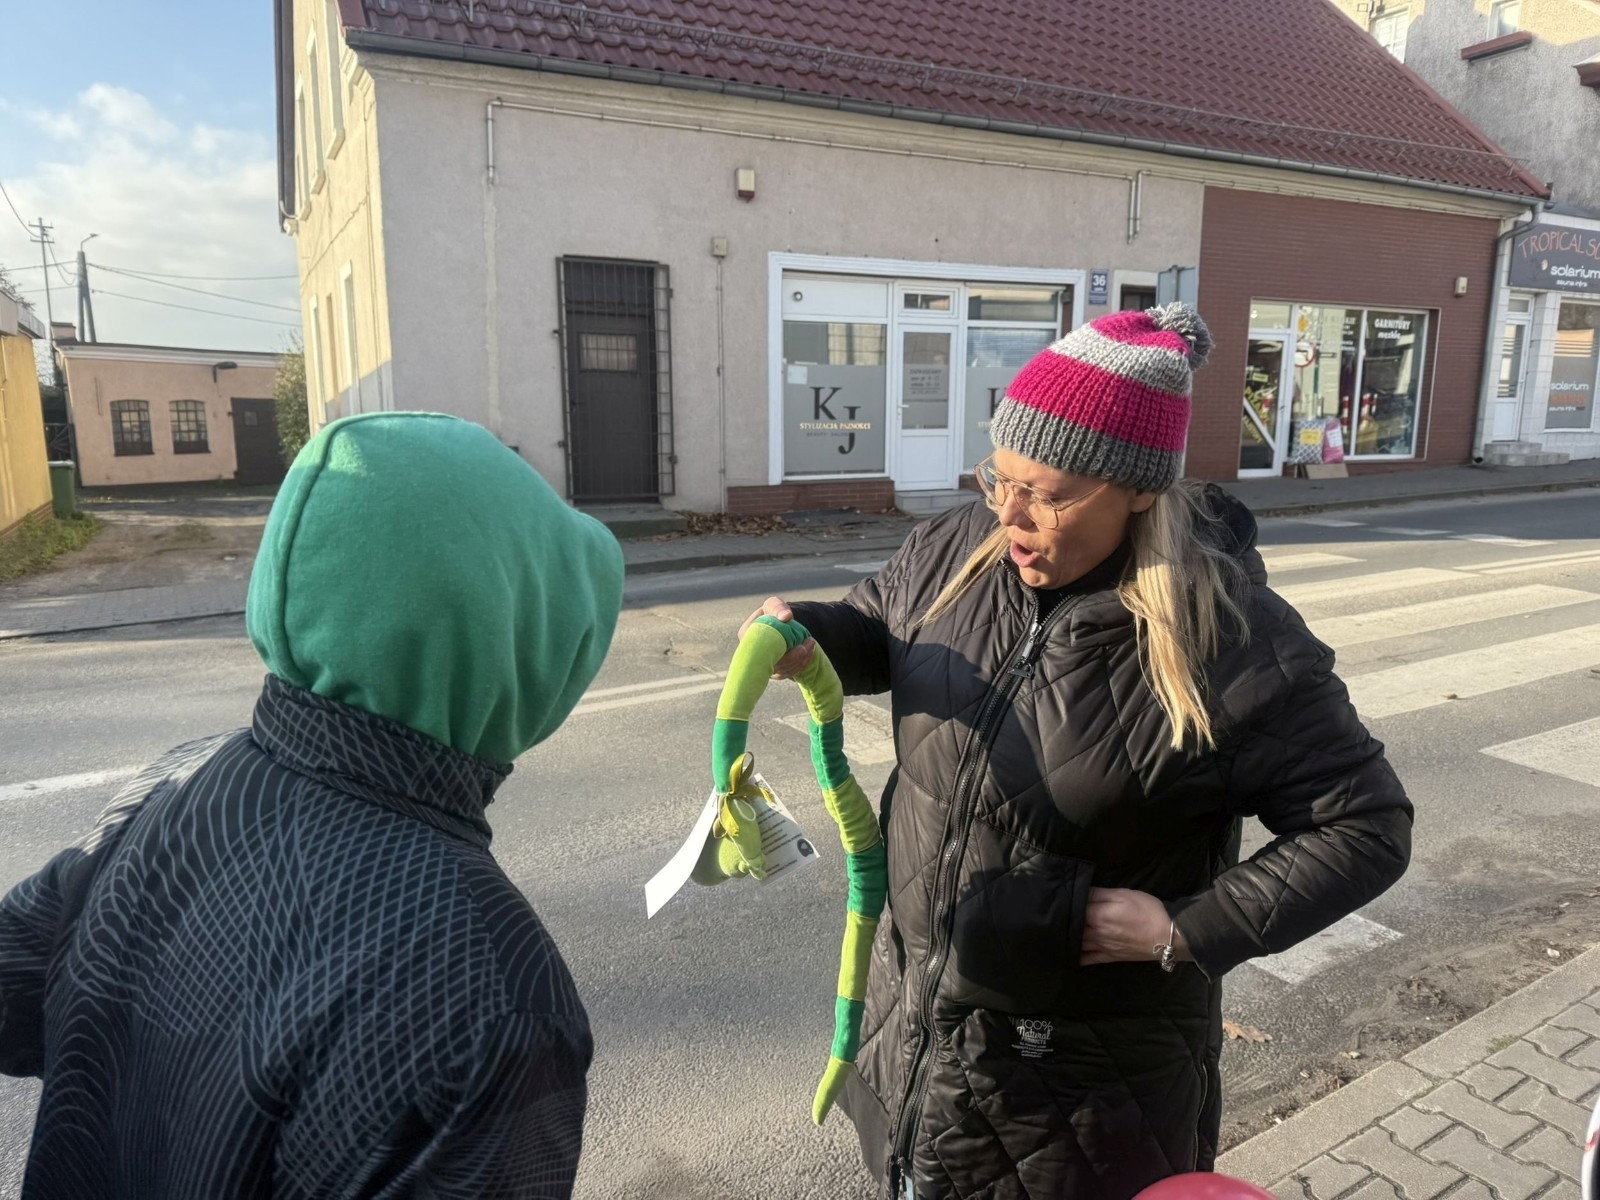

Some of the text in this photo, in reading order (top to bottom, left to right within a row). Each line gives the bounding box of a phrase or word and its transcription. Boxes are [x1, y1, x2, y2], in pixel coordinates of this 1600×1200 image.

[1518, 231, 1585, 259] TROPICAL
[1550, 263, 1600, 279] solarium
[1092, 274, 1106, 287] 36
[1374, 318, 1411, 331] GARNITURY
[1550, 381, 1589, 391] solarium
